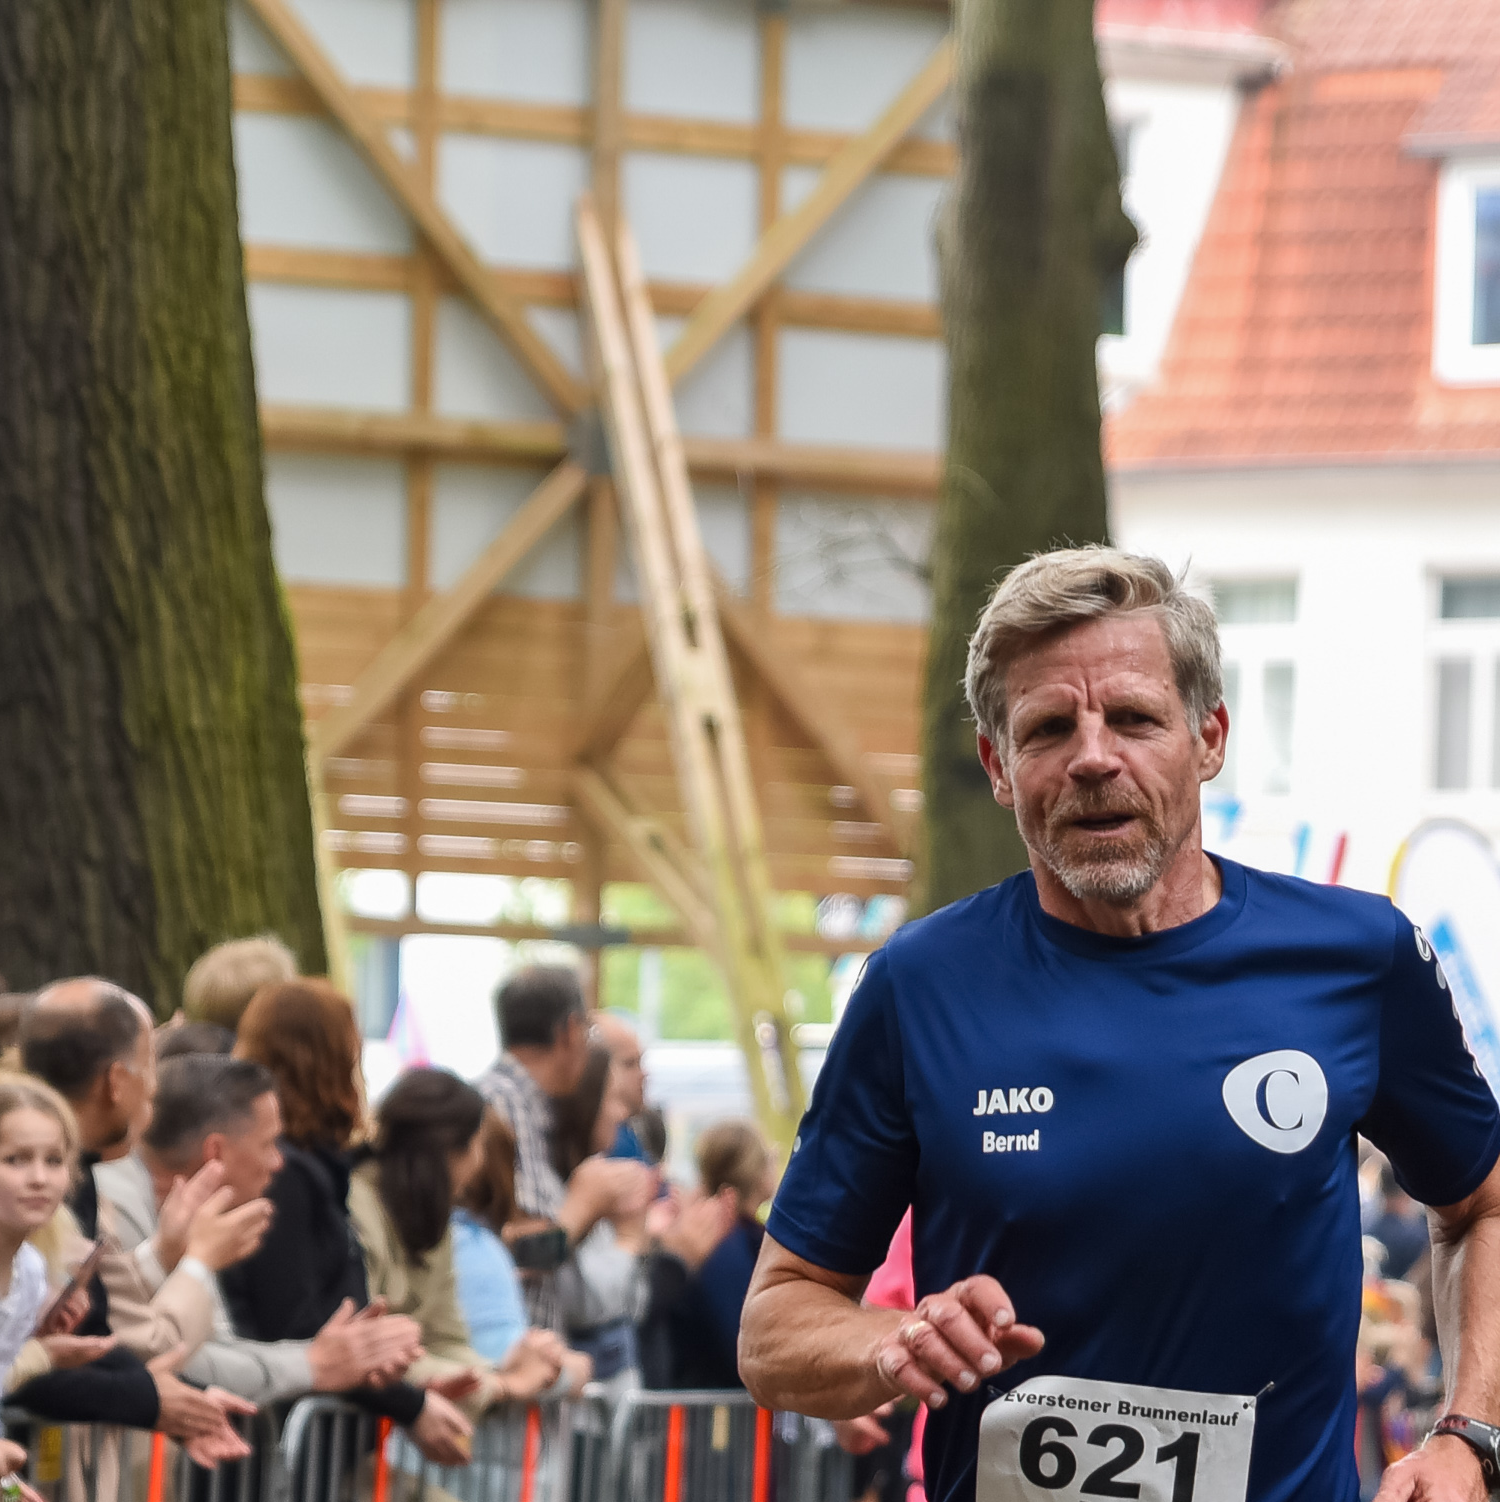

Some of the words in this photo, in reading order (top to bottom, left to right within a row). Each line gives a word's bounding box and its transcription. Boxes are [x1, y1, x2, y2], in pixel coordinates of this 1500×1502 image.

[973, 1086, 1054, 1116] JAKO
[1255, 1069, 1304, 1131] C
[982, 1128, 1040, 1153] Bernd
[1004, 1389, 1111, 1414] Everstener
[1117, 1400, 1240, 1427] Brunnenlauf
